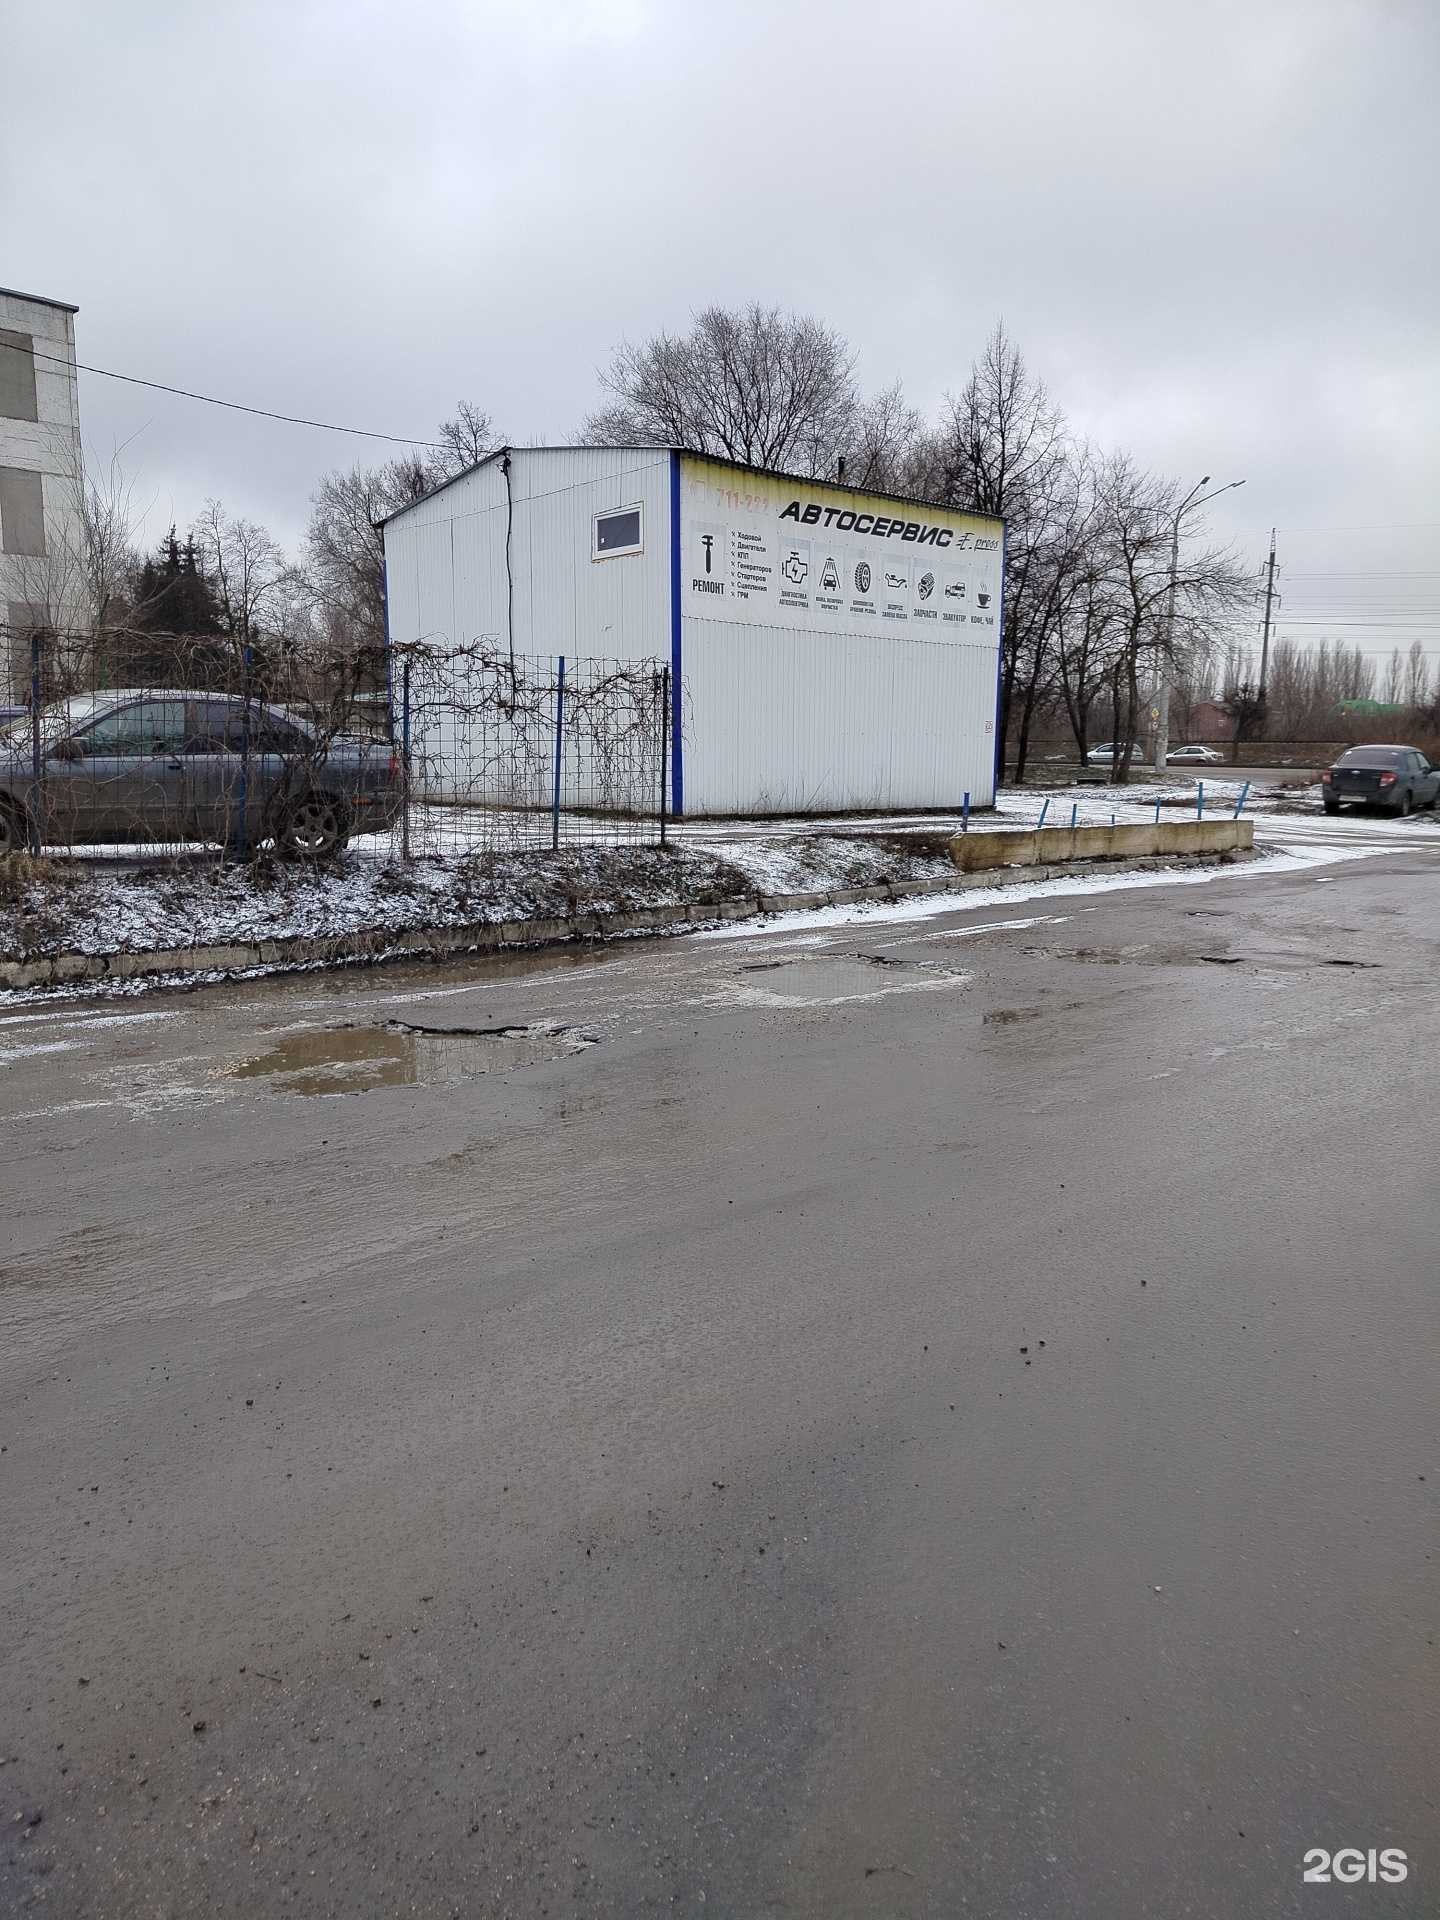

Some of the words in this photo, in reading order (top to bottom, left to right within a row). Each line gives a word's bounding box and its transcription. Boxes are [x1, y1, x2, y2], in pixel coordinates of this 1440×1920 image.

[779, 501, 953, 547] АВТОСЕРВИС
[738, 531, 761, 542] Ходовой
[737, 551, 749, 560] КПП
[692, 578, 725, 595] РЕМОНТ
[737, 591, 749, 599] ГРМ
[913, 608, 938, 619] ЗАПЧАСТИ
